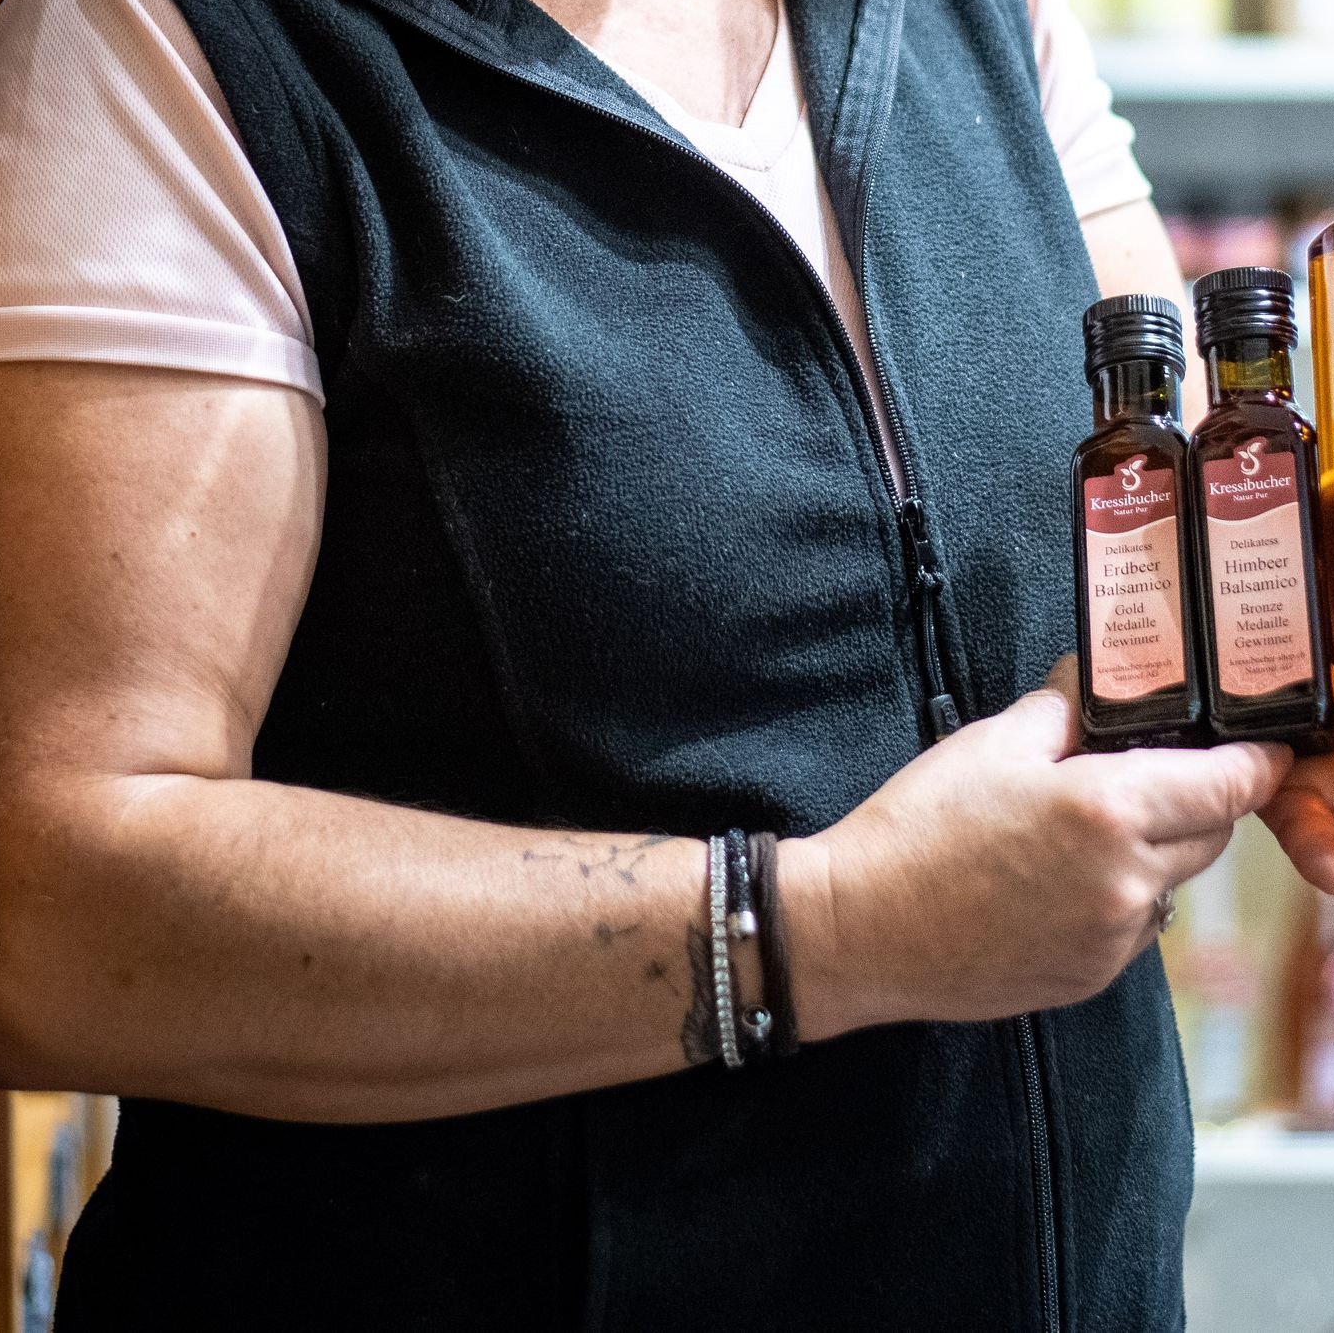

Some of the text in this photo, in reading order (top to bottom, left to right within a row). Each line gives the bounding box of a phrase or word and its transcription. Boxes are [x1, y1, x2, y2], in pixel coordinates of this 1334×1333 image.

[1209, 474, 1291, 496] Kressibucher
[1090, 490, 1171, 511] Kressibucher
[1232, 492, 1268, 502] Natur Pur
[1113, 506, 1148, 516] Natur Pur
[1105, 543, 1153, 556] Delikatess
[1230, 537, 1279, 550] Delikatess
[1103, 561, 1161, 577] Erdbeer
[1225, 557, 1289, 574] Himbeer
[1095, 577, 1171, 598] Balsamico
[1220, 575, 1298, 595] Balsamico
[1114, 602, 1145, 616] Gold
[1240, 601, 1284, 615] Bronze
[1104, 616, 1157, 633] Medaille
[1236, 616, 1289, 633] Medaille
[1102, 633, 1161, 649] Gewinner
[1234, 633, 1293, 649] Gewinner
